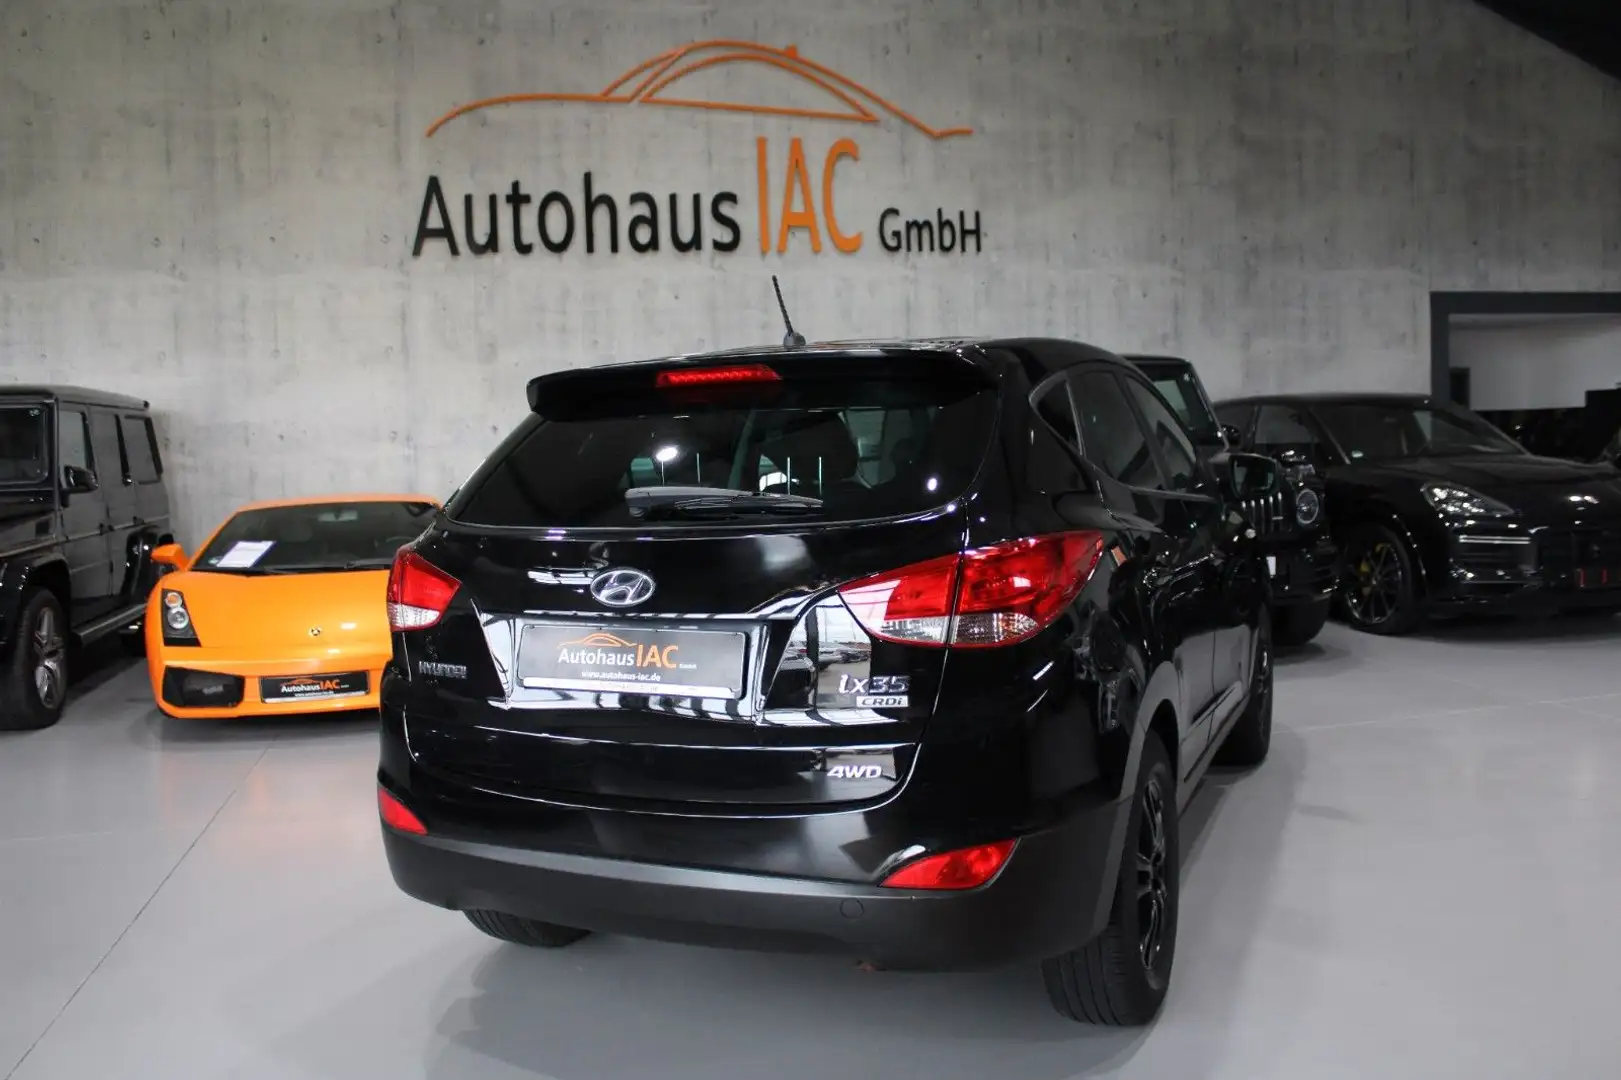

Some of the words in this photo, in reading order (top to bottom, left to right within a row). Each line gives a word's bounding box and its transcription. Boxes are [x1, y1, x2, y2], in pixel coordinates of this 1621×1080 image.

[412, 171, 741, 257] Autohaus
[756, 136, 863, 254] IAC
[879, 207, 983, 254] GmbH
[557, 647, 635, 667] Autohaus
[636, 644, 679, 669] IAC
[581, 670, 662, 682] www.autohaus-iac.de
[281, 683, 320, 693] Autohaus
[320, 679, 340, 690] IAC
[827, 765, 882, 778] 4WD
